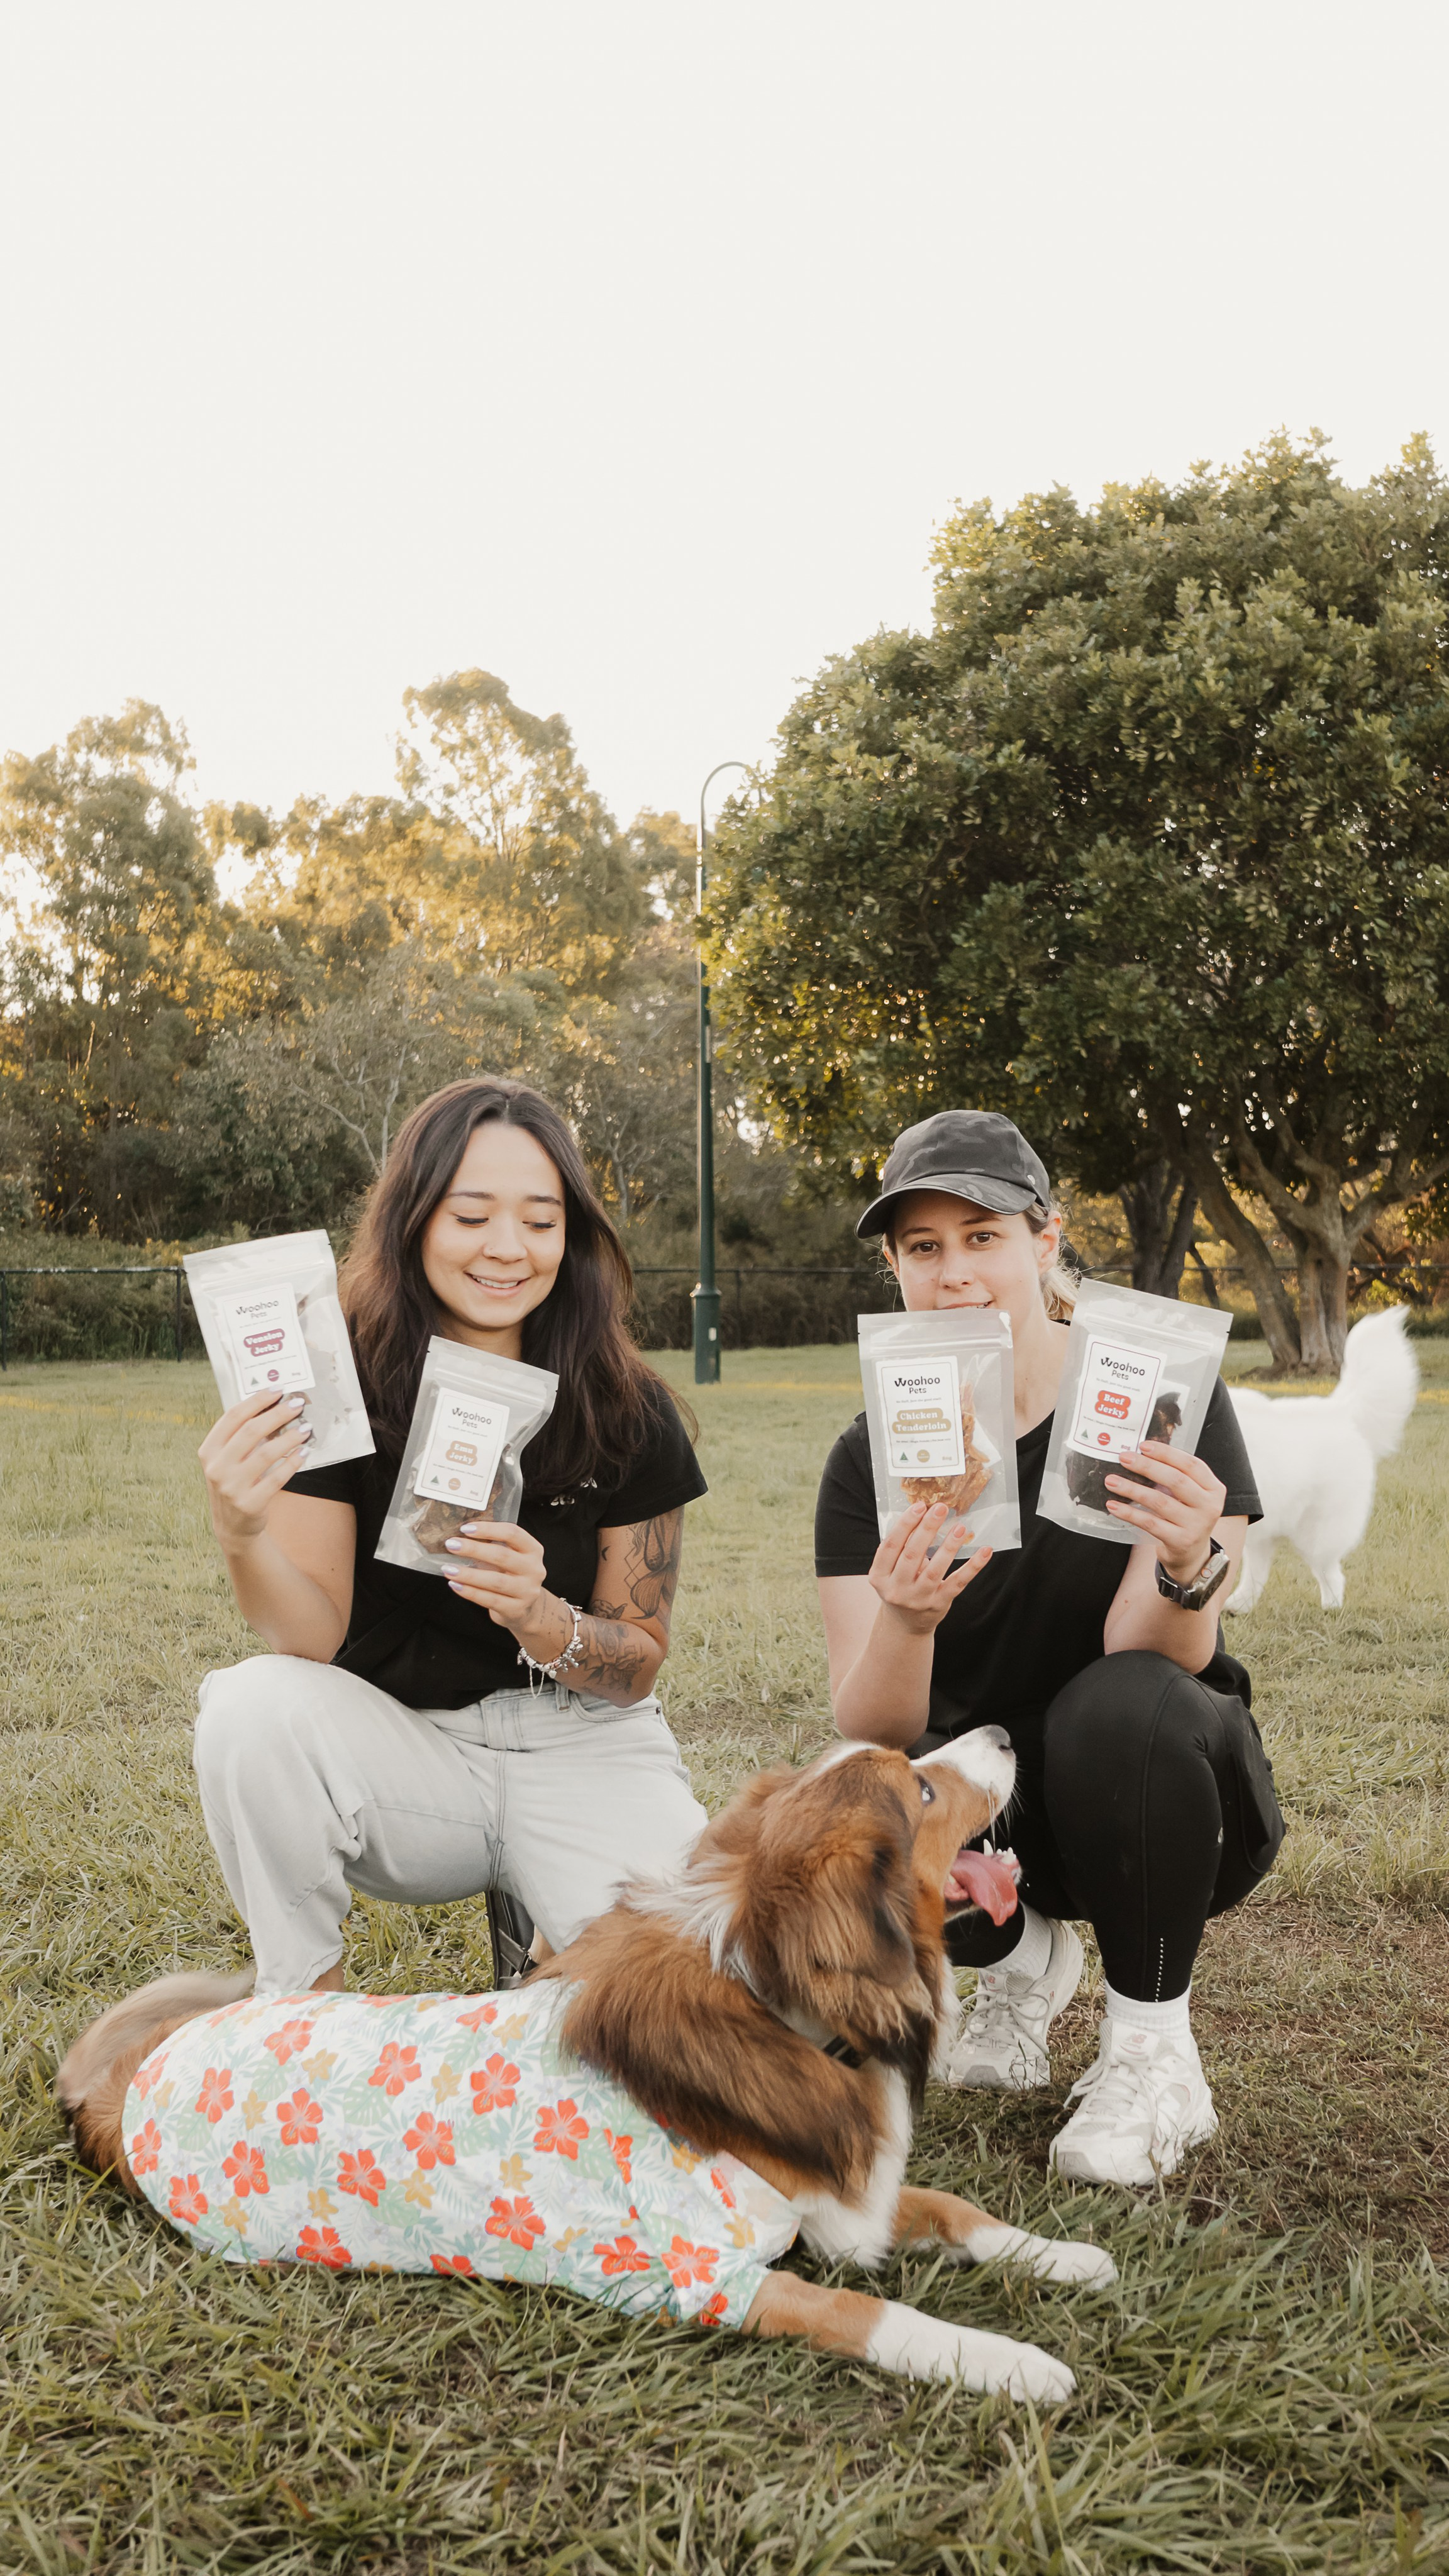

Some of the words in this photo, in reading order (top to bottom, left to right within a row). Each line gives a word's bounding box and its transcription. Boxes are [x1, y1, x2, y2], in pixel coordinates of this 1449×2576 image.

[236, 1301, 279, 1314] Woohoo
[255, 1343, 280, 1354] Jerky
[1101, 1357, 1145, 1375] Woohoo
[1111, 1370, 1130, 1380] Pets
[894, 1376, 940, 1387] Woohoo
[1104, 1393, 1125, 1406] Beef
[452, 1407, 492, 1424] Woohoo
[900, 1412, 938, 1420] Chicken
[1098, 1404, 1126, 1418] Jerky
[462, 1419, 478, 1428] Pets
[896, 1422, 947, 1431] Tenderloin
[454, 1443, 473, 1454] Emu
[449, 1452, 474, 1465] Jerky
